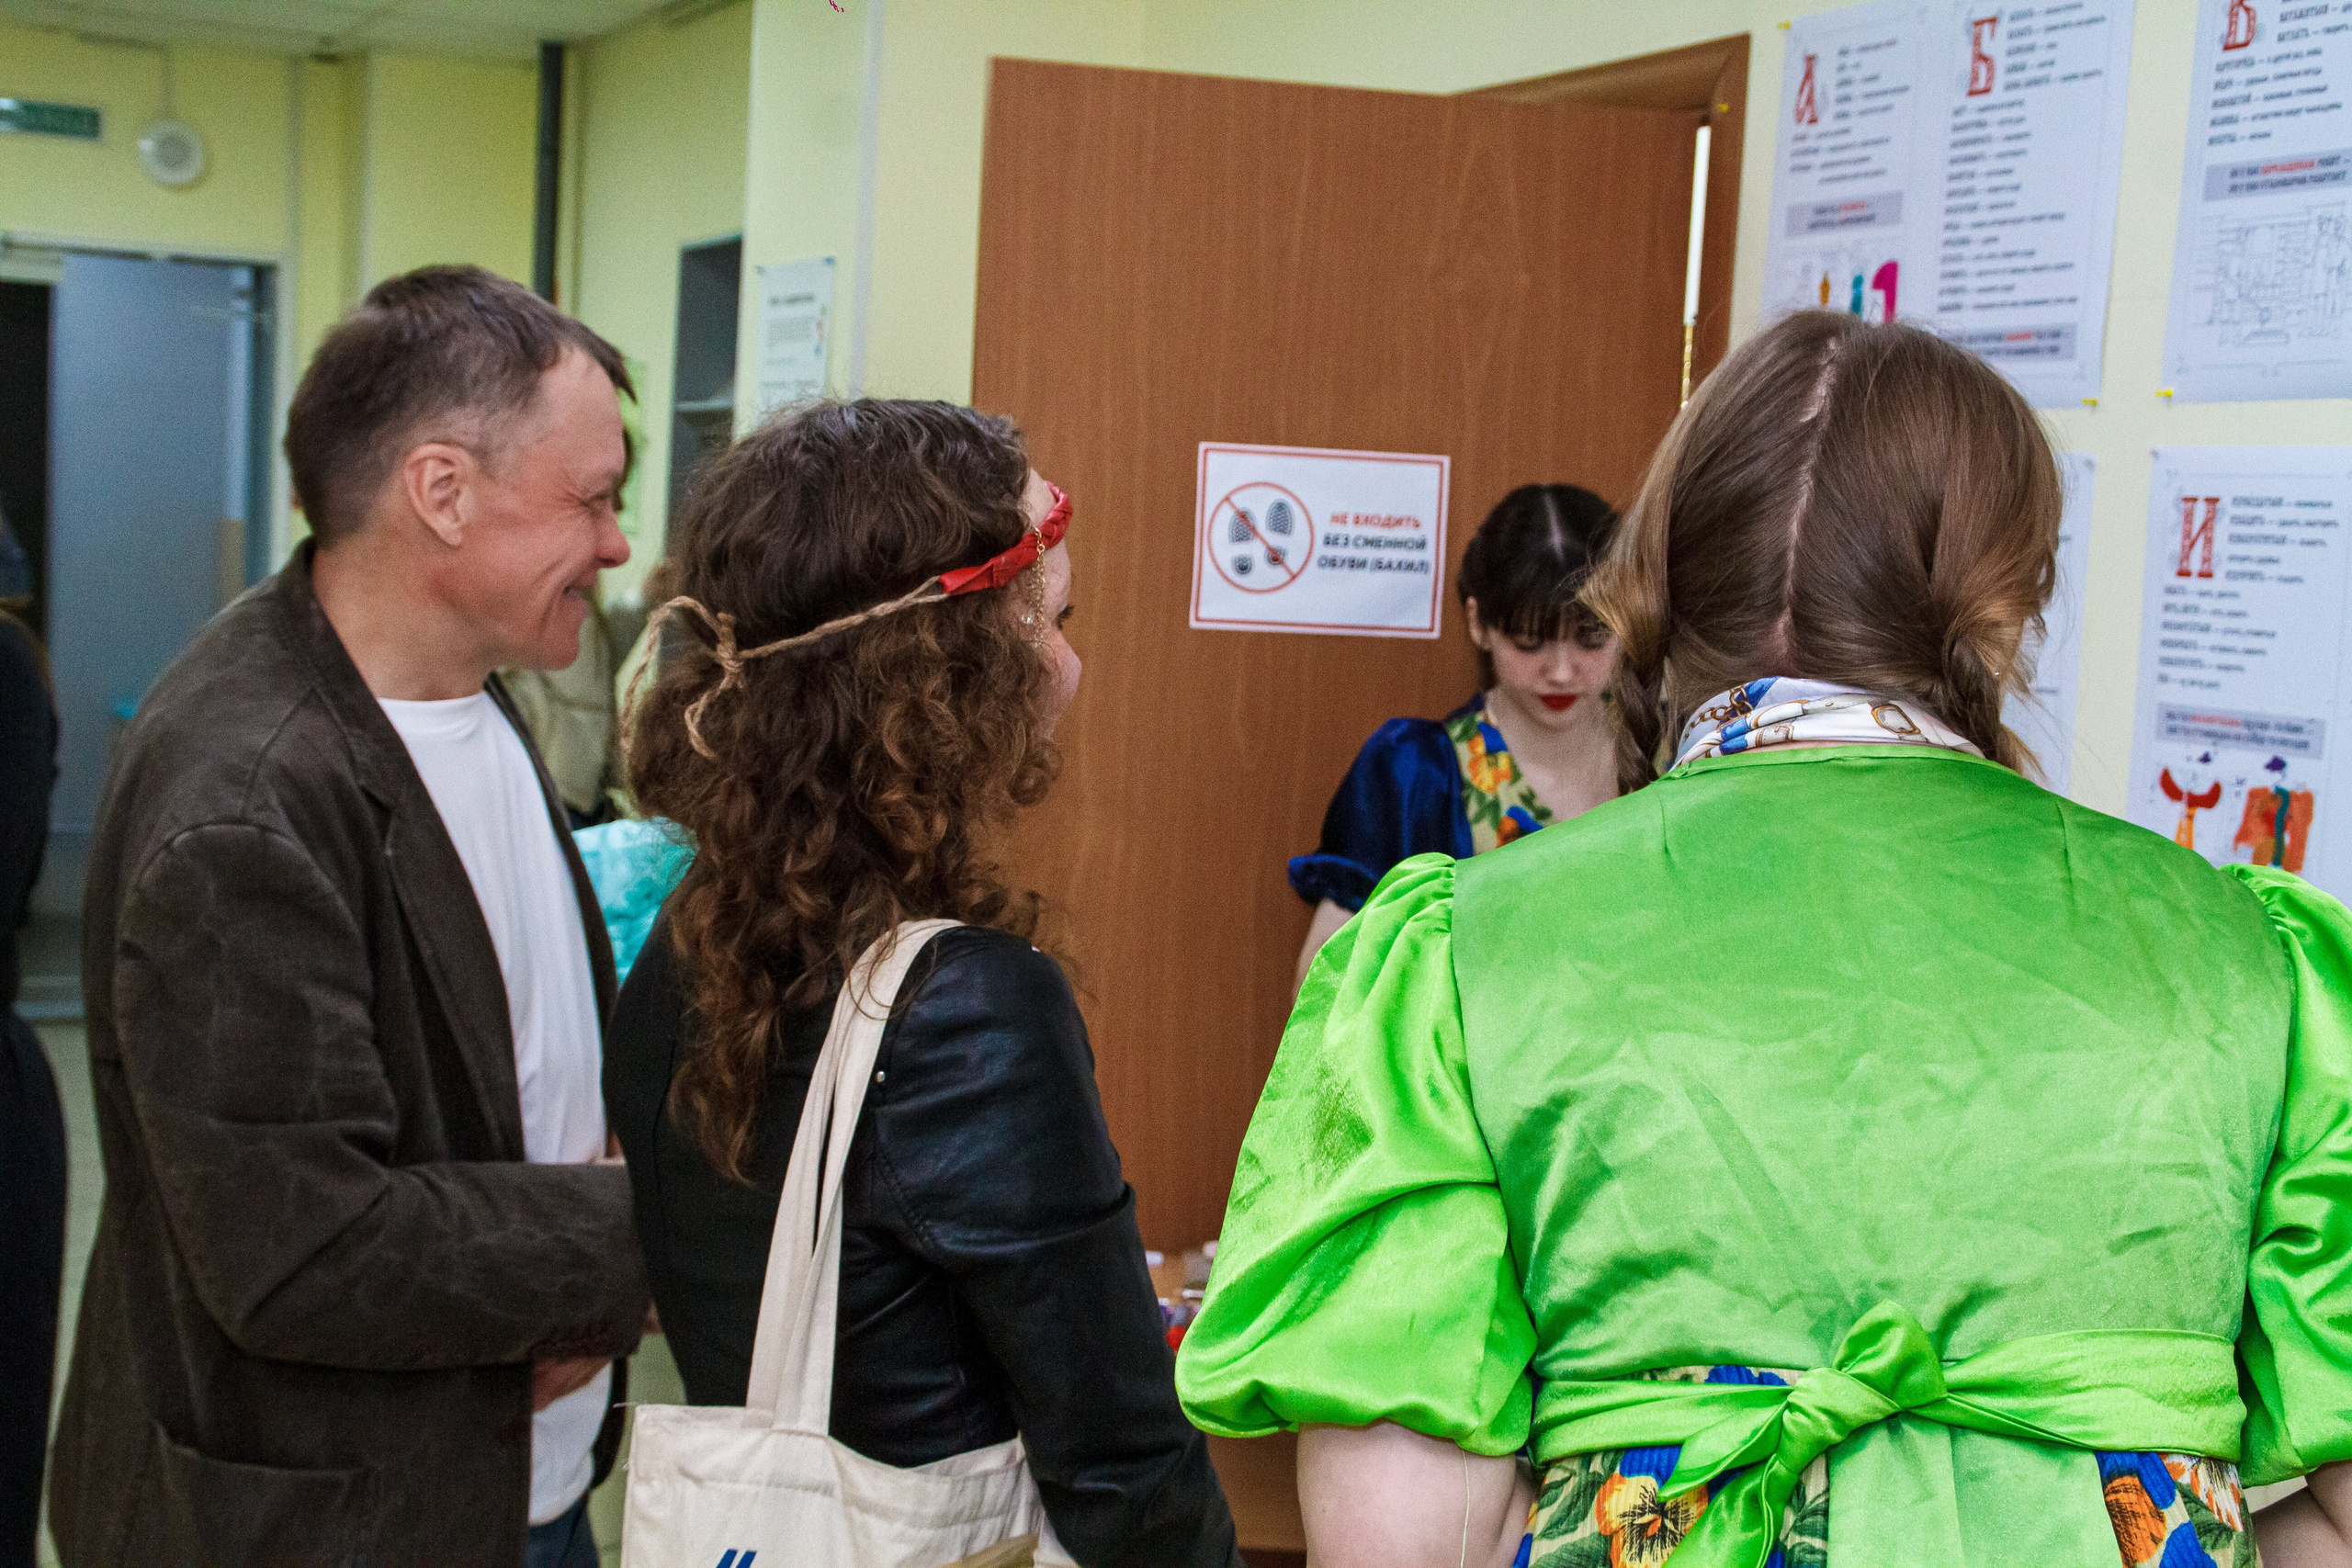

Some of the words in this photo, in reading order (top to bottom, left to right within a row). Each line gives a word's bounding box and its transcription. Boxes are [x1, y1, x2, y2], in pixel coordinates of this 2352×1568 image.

[1966, 16, 1998, 97] Б
[1329, 512, 1349, 526] НЕ
[1352, 513, 1421, 530] ВХОДИТЬ
[1323, 533, 1350, 548] БЕЗ
[1352, 534, 1427, 551] СМЕННОЙ
[2176, 496, 2220, 578] И
[1317, 554, 1368, 570] ОБУВИ
